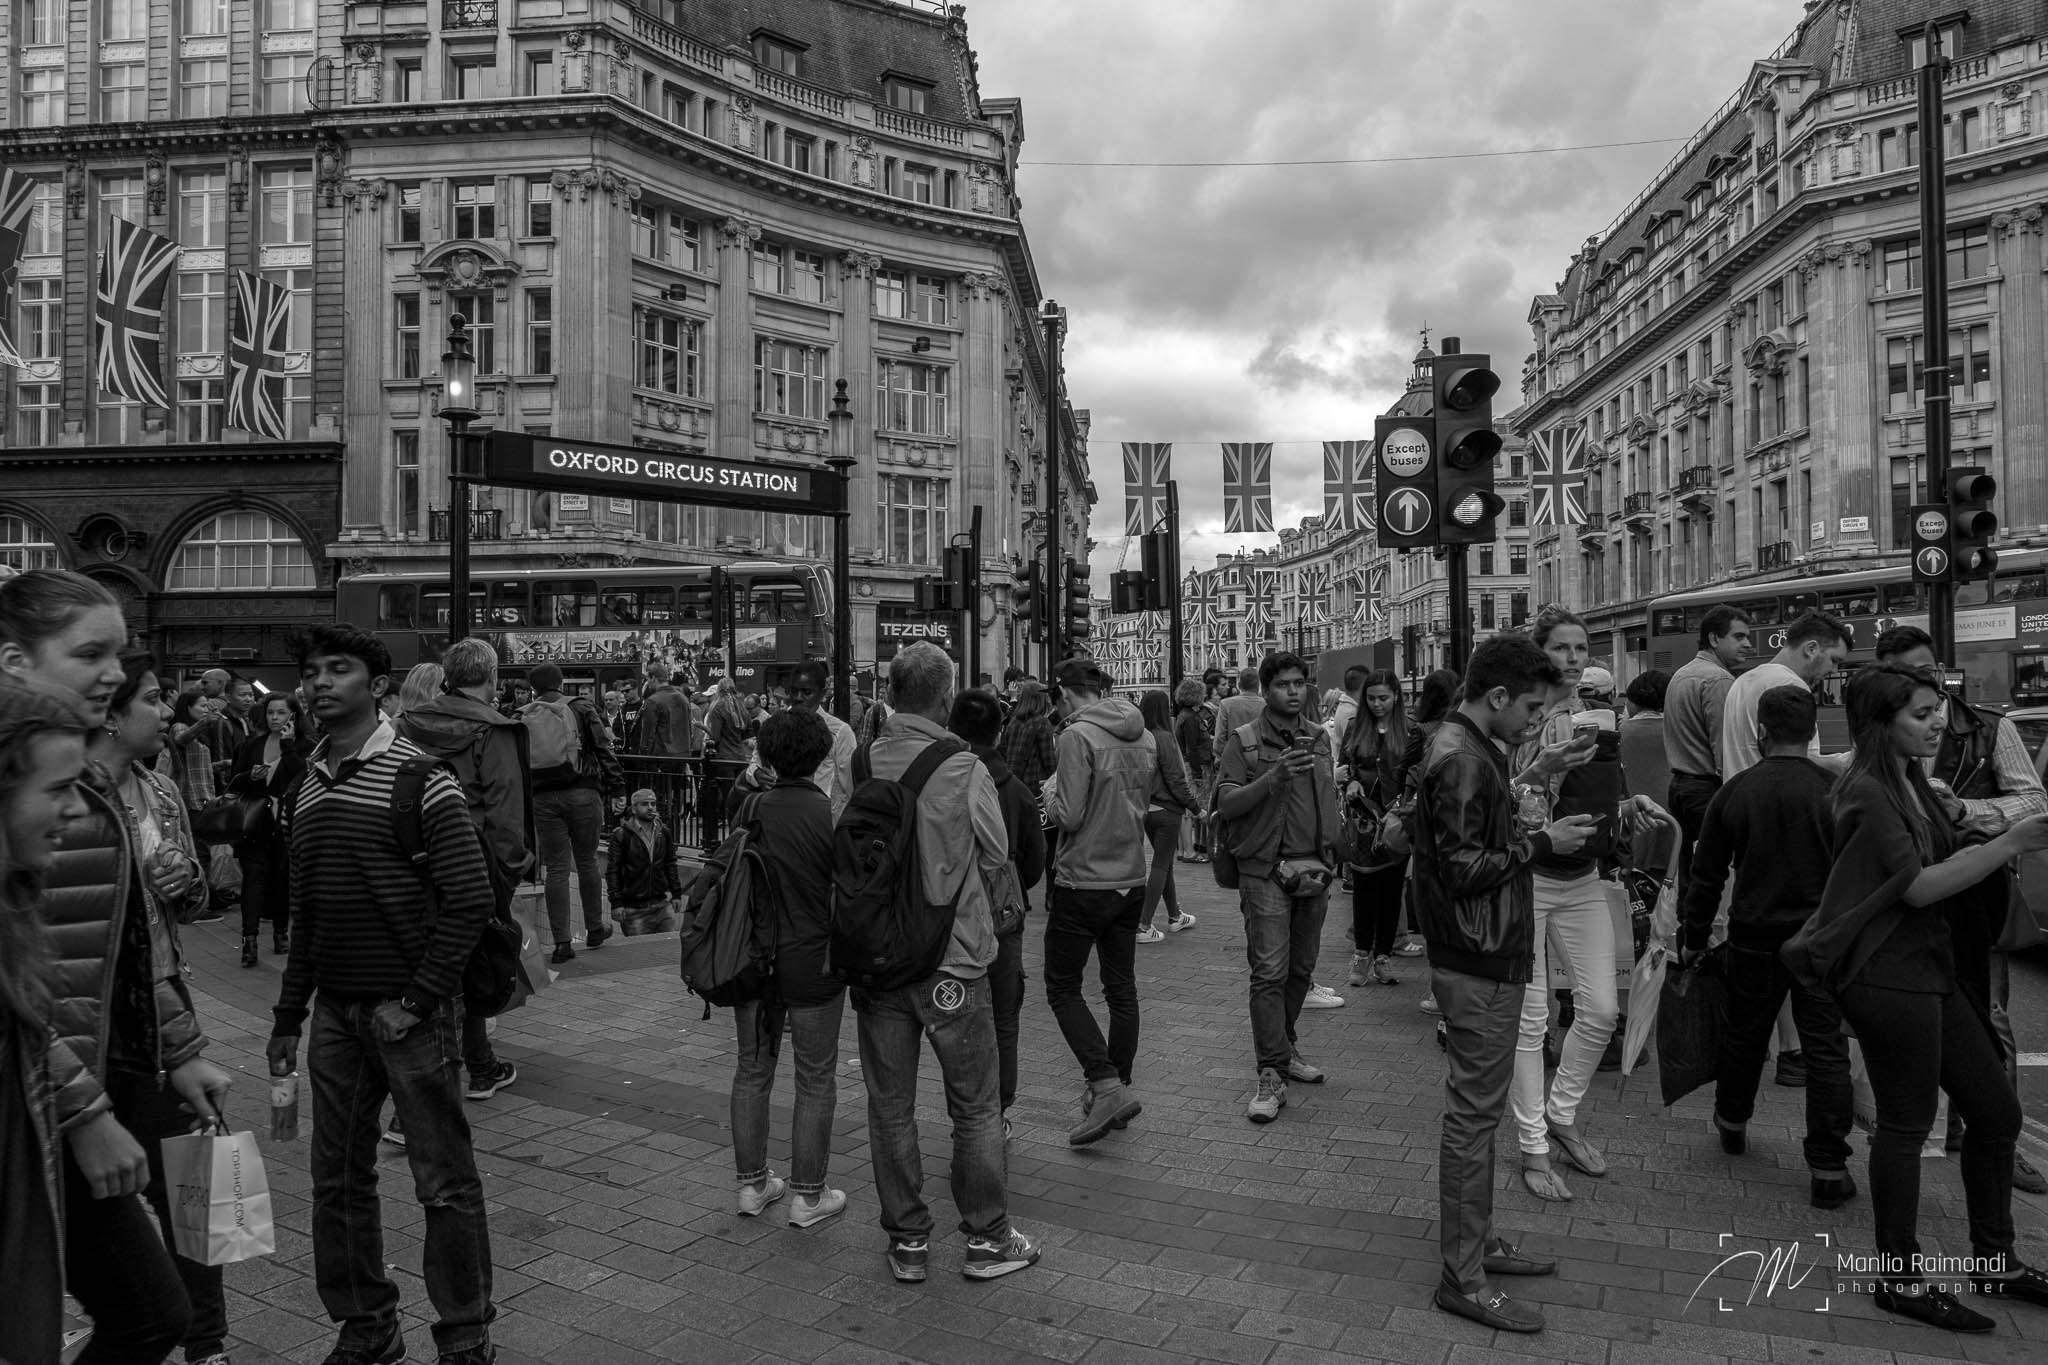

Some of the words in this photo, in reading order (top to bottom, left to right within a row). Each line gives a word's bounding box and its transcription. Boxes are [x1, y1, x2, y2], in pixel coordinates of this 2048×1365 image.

[1386, 443, 1427, 455] Except
[1390, 456, 1424, 466] buses
[549, 449, 639, 475] OXFORD
[644, 460, 714, 484] CIRCUS
[719, 468, 798, 492] STATION
[518, 639, 614, 654] X-MEN
[518, 653, 613, 661] APOCALYPSE
[231, 1147, 246, 1228] TOPSHOP.COM
